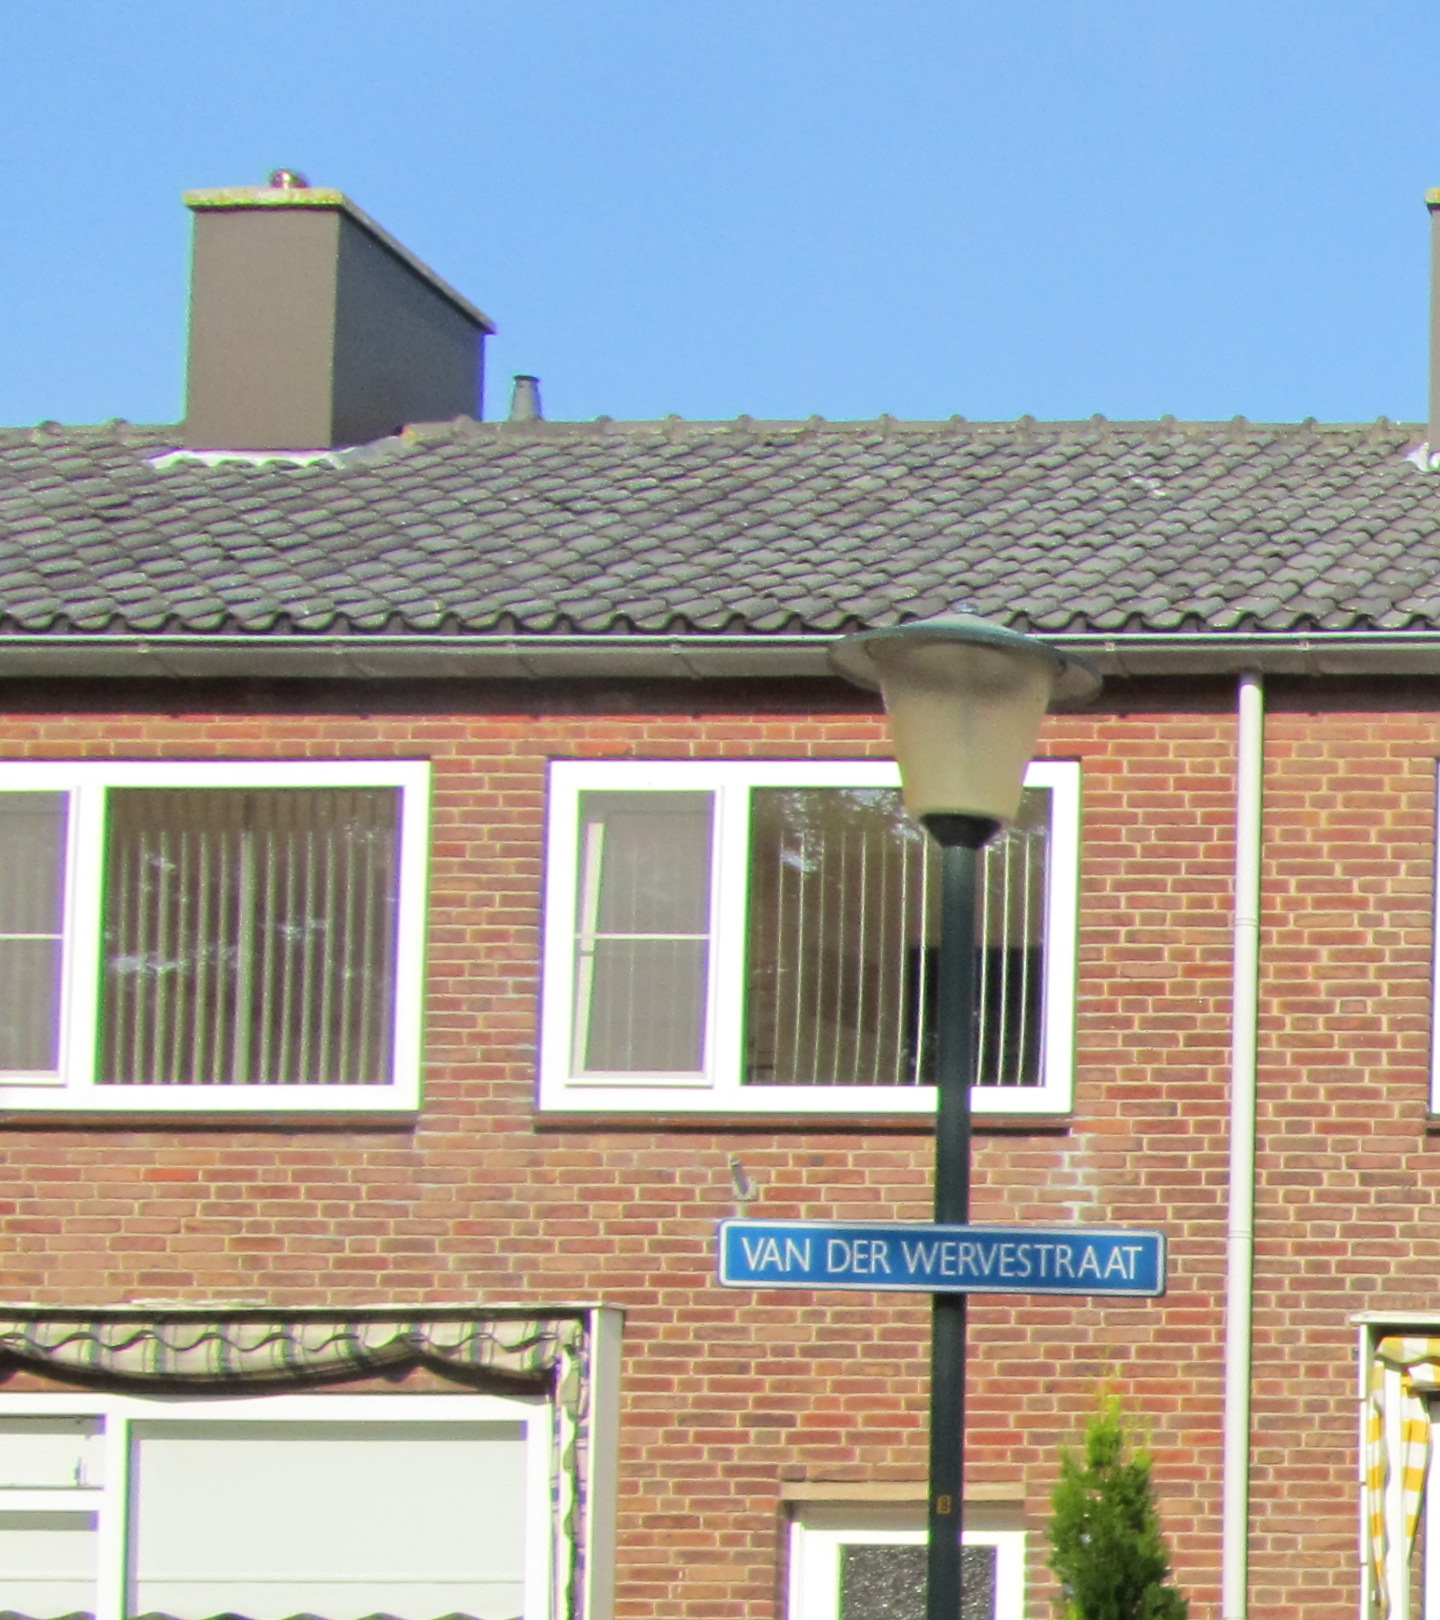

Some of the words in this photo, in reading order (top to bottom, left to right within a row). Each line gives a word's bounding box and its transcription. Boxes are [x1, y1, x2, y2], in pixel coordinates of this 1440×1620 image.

[741, 1237, 810, 1273] VAN
[827, 1239, 891, 1274] DER
[902, 1241, 1142, 1279] WERVESTRAAT
